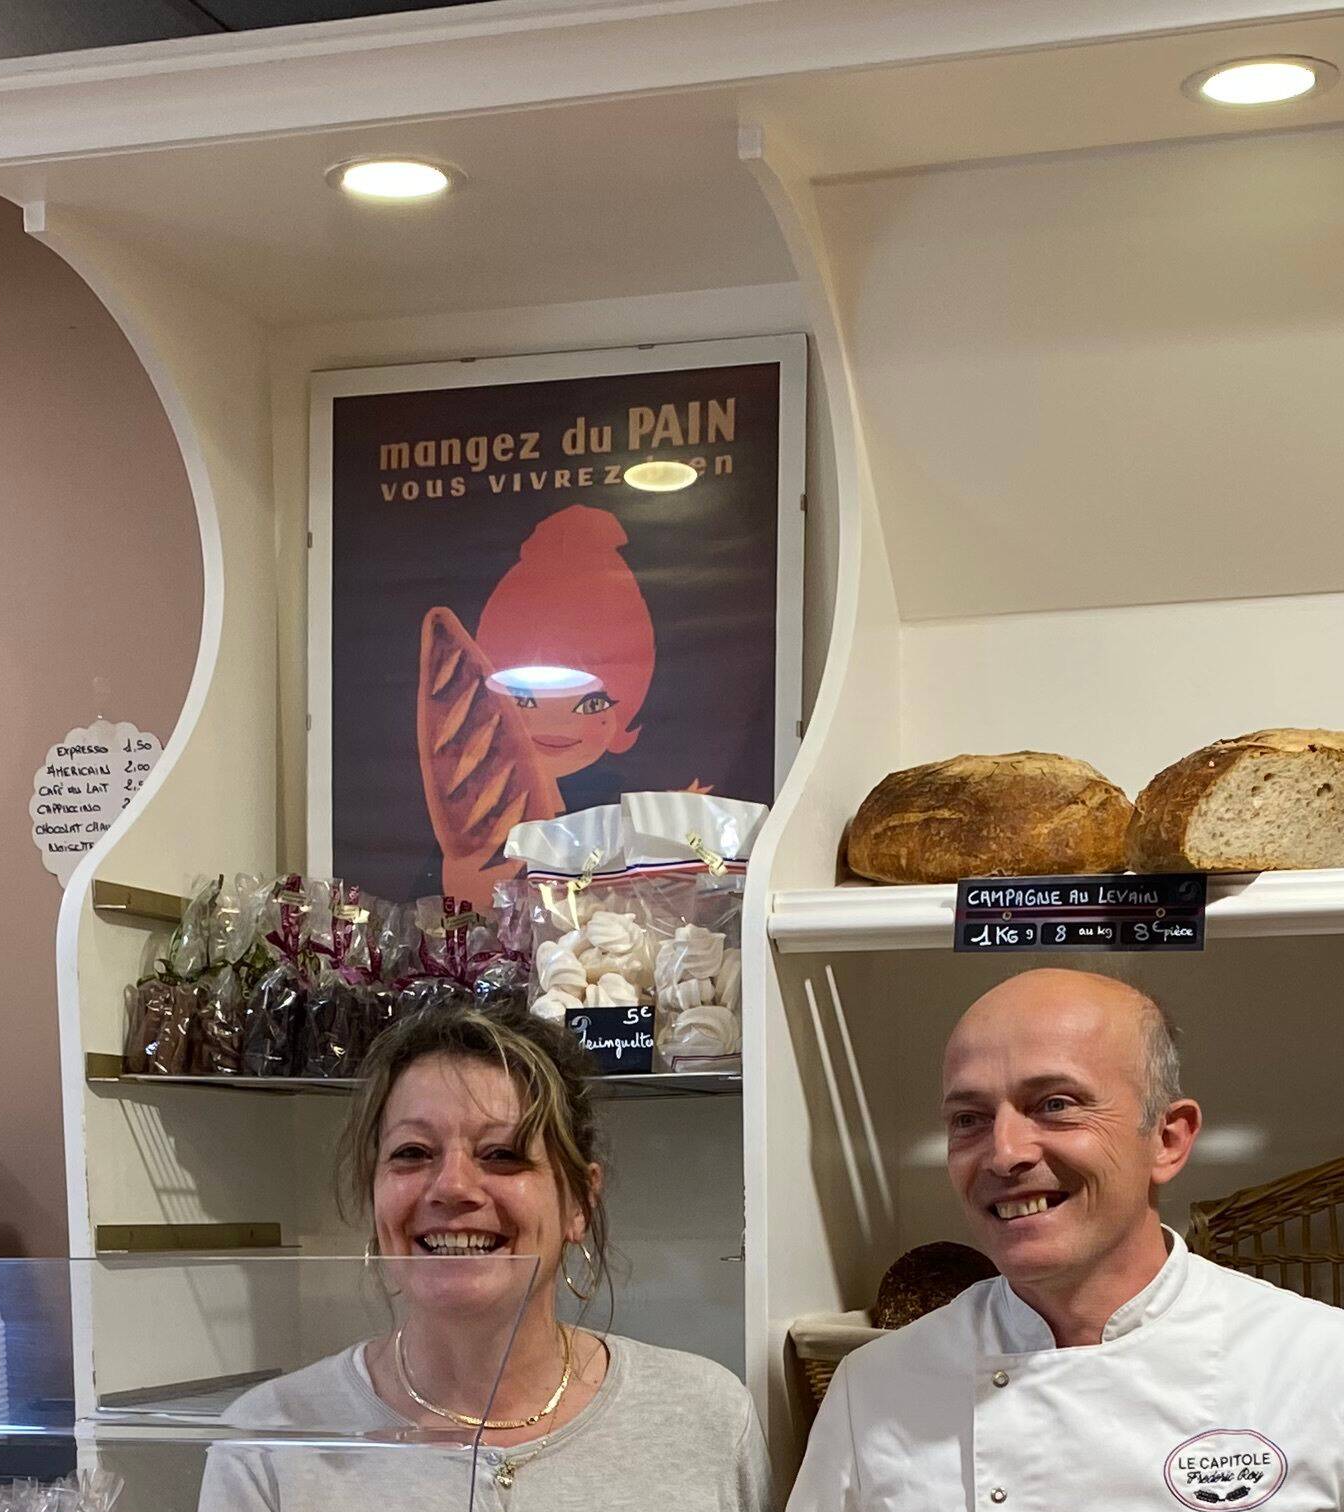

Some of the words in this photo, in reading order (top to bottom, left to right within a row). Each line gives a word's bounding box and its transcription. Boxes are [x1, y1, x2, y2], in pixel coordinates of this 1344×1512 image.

[379, 432, 540, 472] mangez
[562, 417, 611, 455] du
[629, 398, 736, 450] PAIN
[489, 465, 621, 494] VIVREZ
[967, 889, 1063, 907] CAMPAGNE
[1069, 890, 1089, 905] AU
[1098, 886, 1159, 905] LEVAIN
[1055, 925, 1067, 942] 8
[1079, 927, 1094, 936] au
[1097, 926, 1113, 939] kg
[1178, 1457, 1196, 1470] LE
[1199, 1452, 1271, 1470] CAPITOLE
